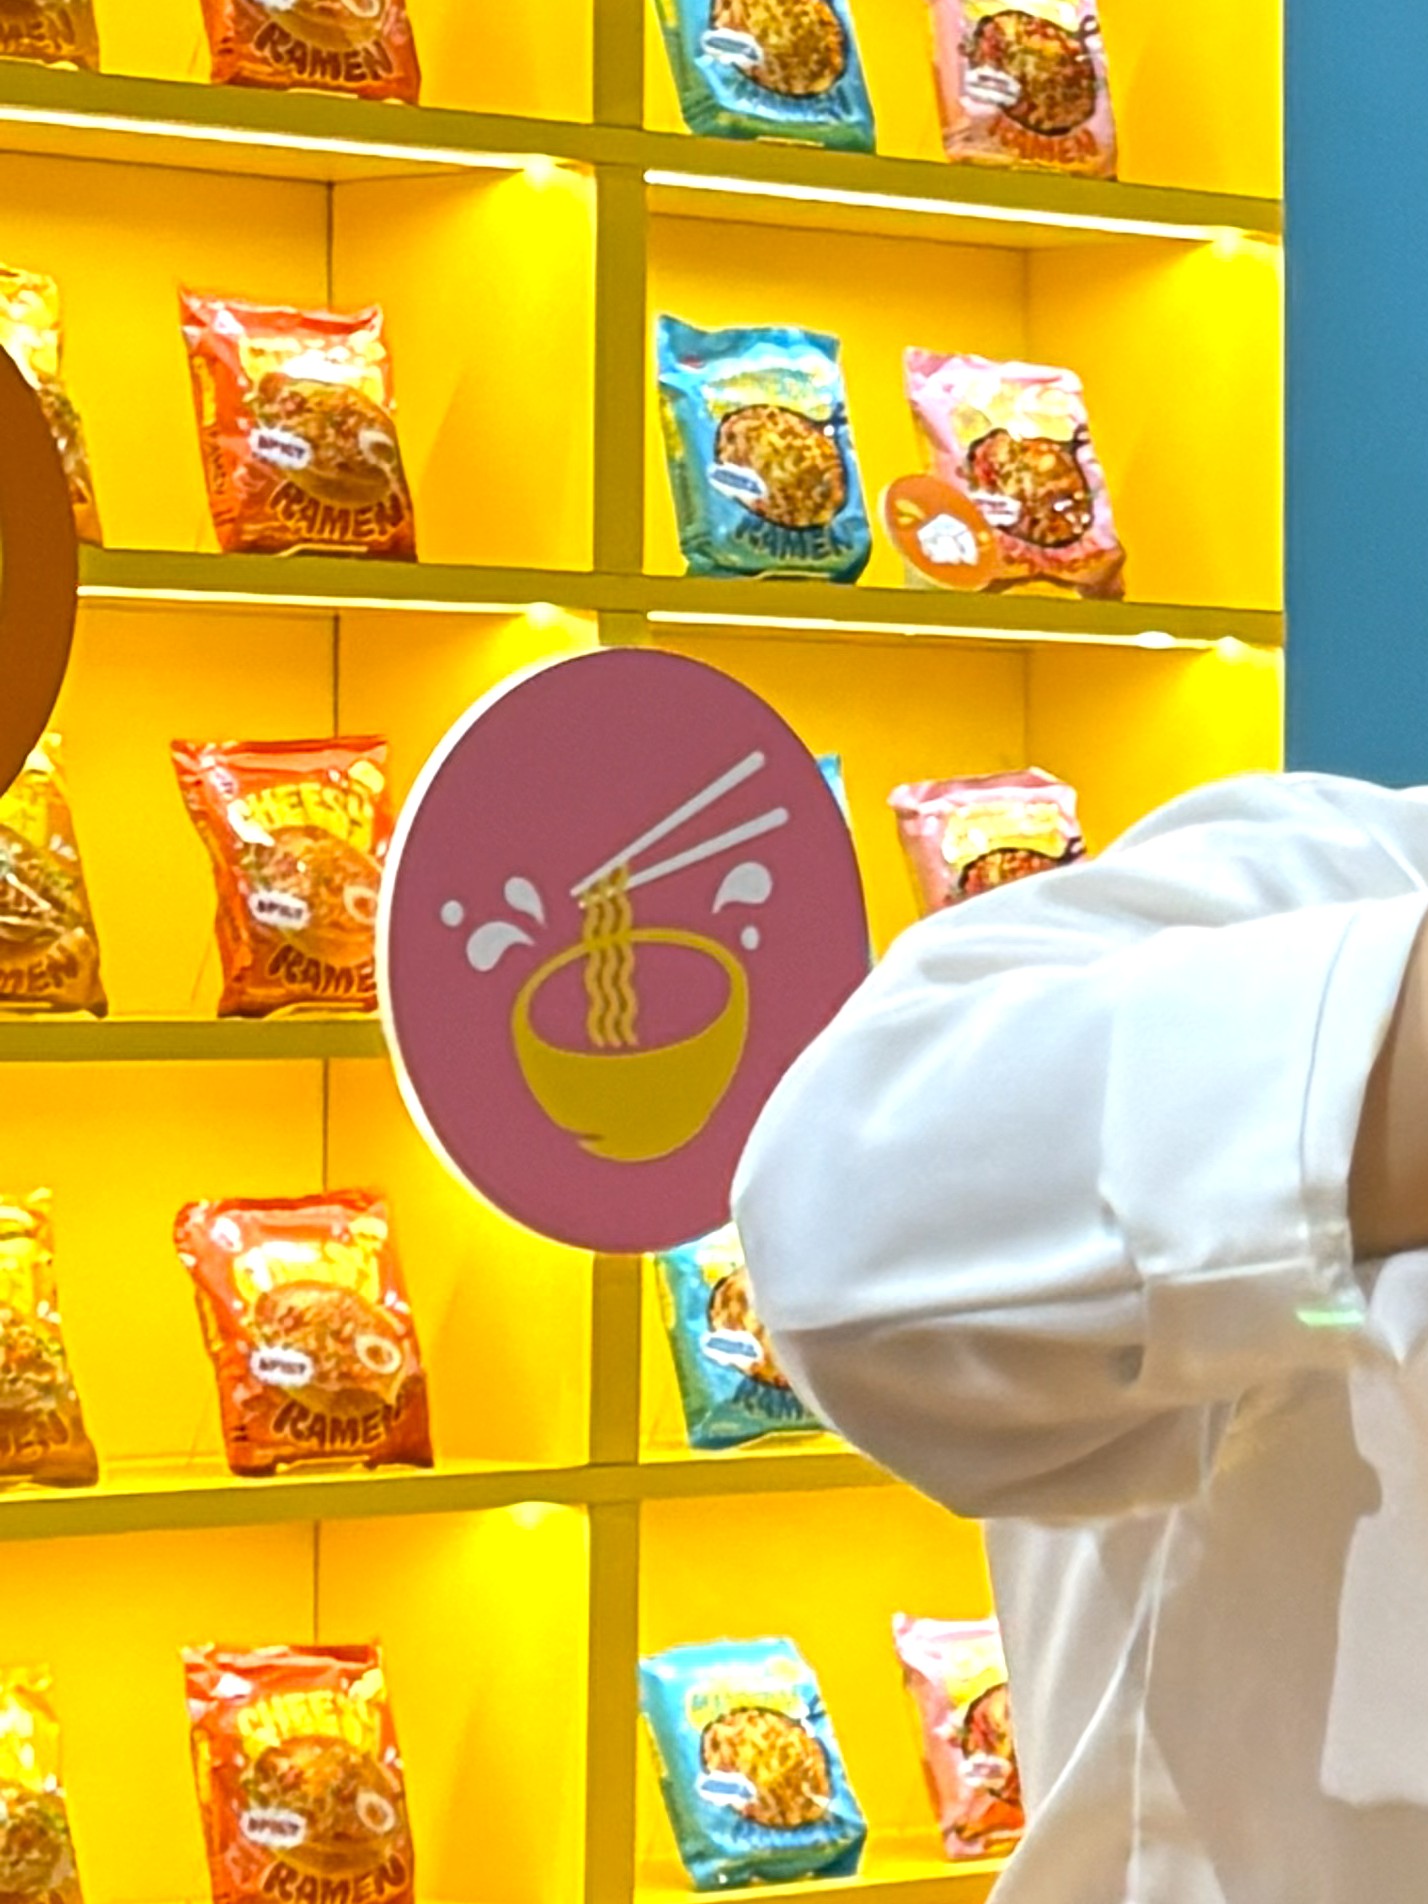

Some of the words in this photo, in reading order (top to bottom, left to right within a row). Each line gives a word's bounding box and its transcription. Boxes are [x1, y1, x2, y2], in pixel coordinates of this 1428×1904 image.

[254, 20, 395, 81] RAMEN
[268, 482, 404, 541] RAMEN
[268, 944, 376, 994] RAME
